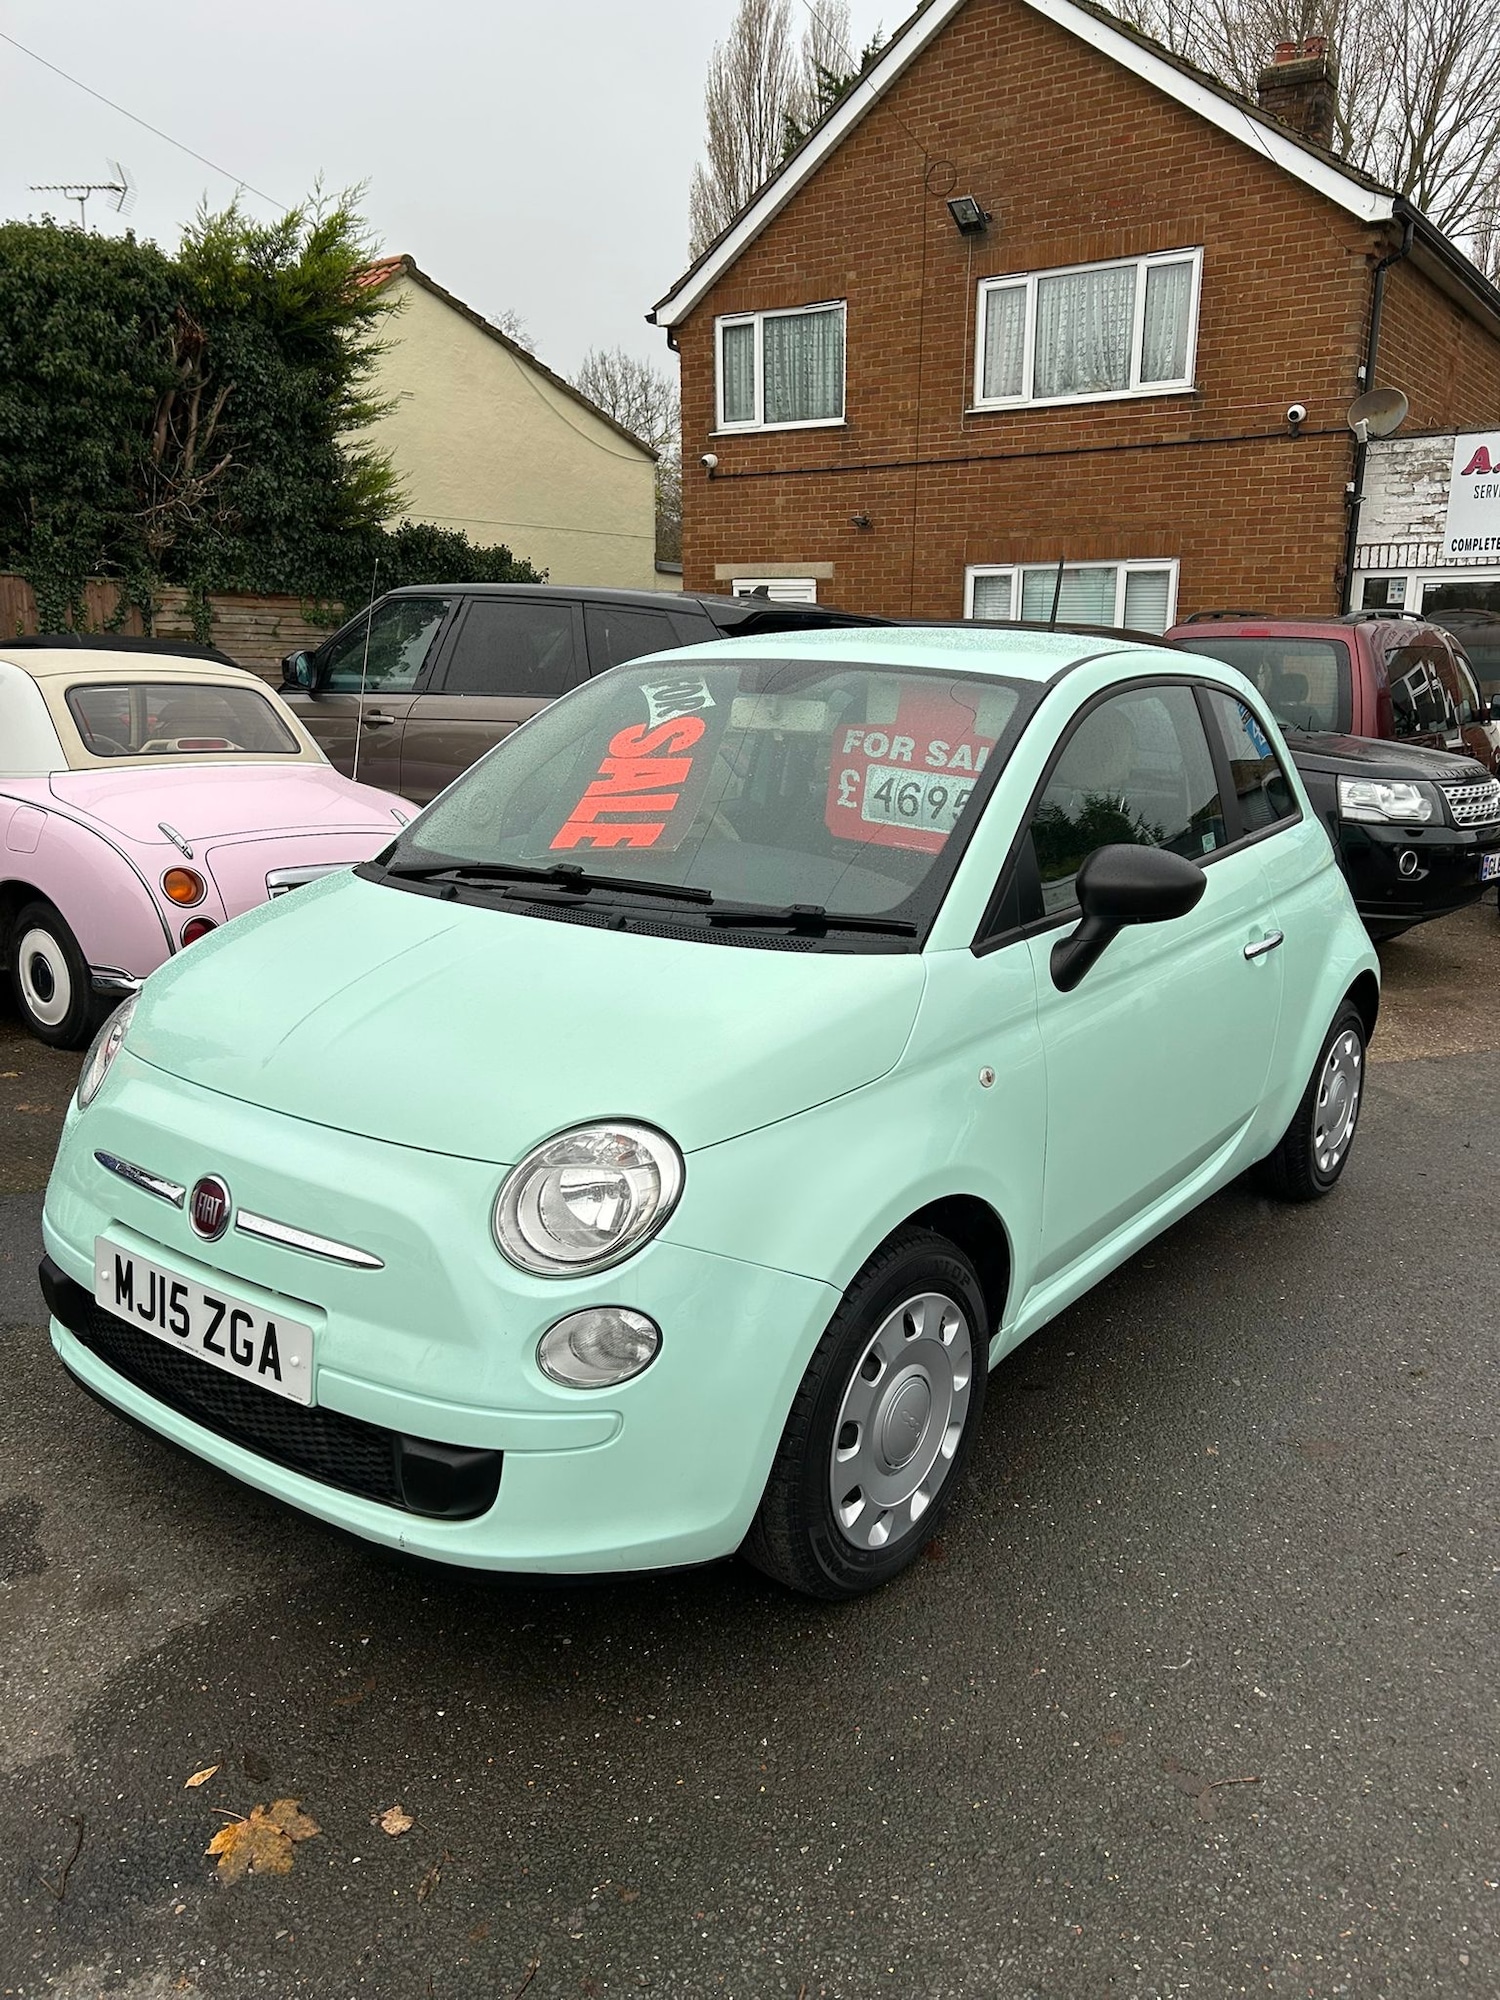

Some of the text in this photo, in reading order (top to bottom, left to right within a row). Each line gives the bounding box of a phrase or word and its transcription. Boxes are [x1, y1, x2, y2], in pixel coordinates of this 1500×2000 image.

[1460, 445, 1500, 476] A
[1473, 484, 1500, 500] SERV
[550, 676, 707, 850] FOR SALE
[842, 729, 990, 773] FOR SAL
[837, 767, 861, 809] £
[199, 1192, 223, 1226] FIAT
[114, 1254, 283, 1382] MJ15 ZGA
